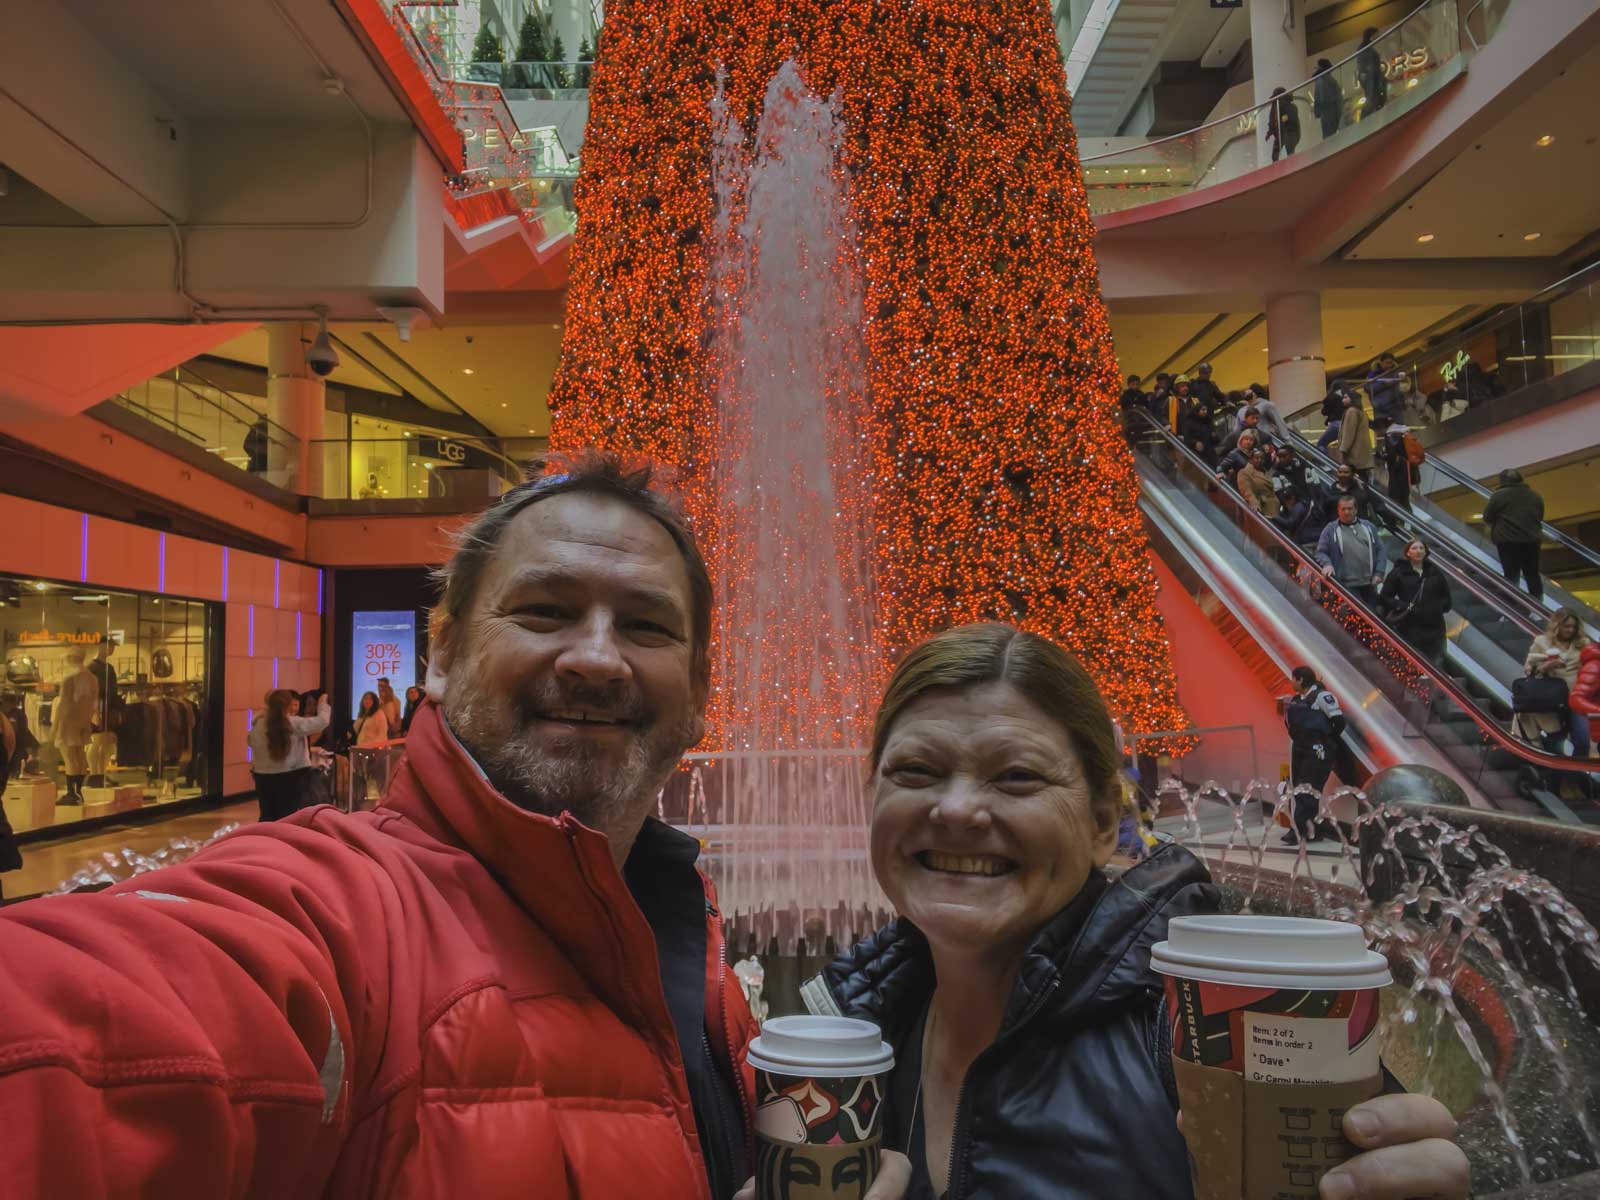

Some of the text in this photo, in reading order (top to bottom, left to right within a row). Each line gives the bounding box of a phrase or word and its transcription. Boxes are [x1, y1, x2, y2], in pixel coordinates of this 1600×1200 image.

[438, 440, 465, 461] UGG
[366, 643, 401, 659] 30%
[365, 660, 401, 676] OFF
[1272, 1028, 1279, 1037] 2
[1280, 1029, 1288, 1038] of
[1289, 1030, 1295, 1039] 2
[1275, 1038, 1283, 1047] in
[1307, 1041, 1314, 1050] 2
[1259, 1054, 1284, 1067] Dave
[1253, 1072, 1265, 1081] Gr
